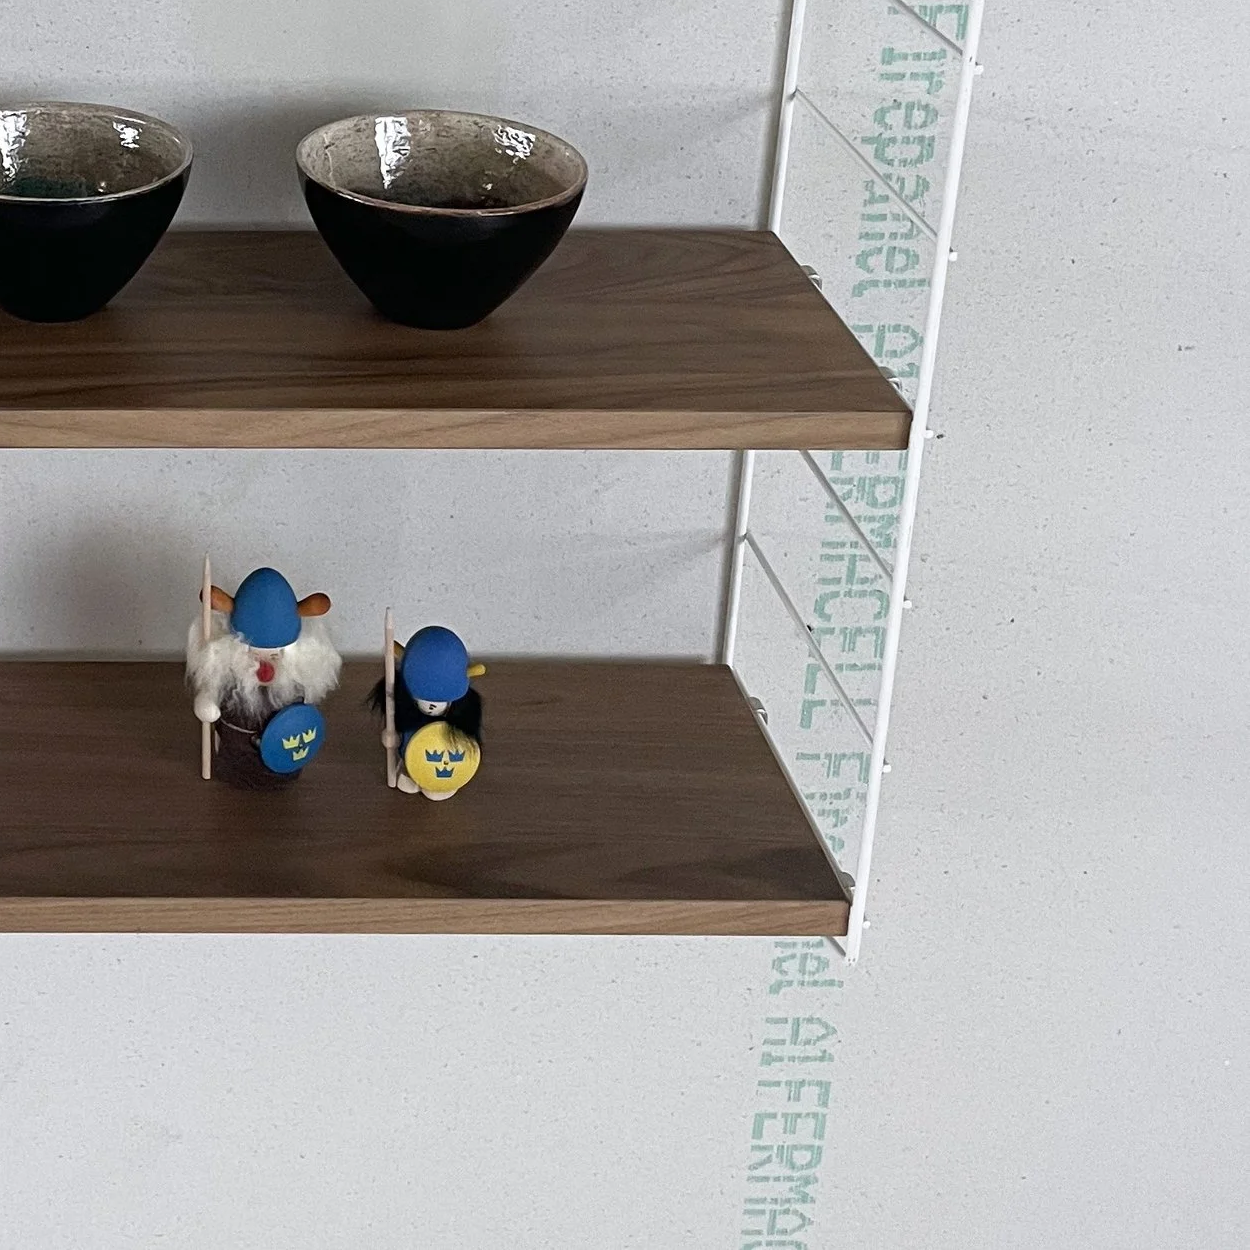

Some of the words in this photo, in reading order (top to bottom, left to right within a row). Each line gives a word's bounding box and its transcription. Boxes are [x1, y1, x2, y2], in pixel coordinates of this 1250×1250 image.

[851, 4, 970, 298] Firepanel
[800, 450, 909, 730] ERMACELL
[759, 1016, 843, 1068] A1
